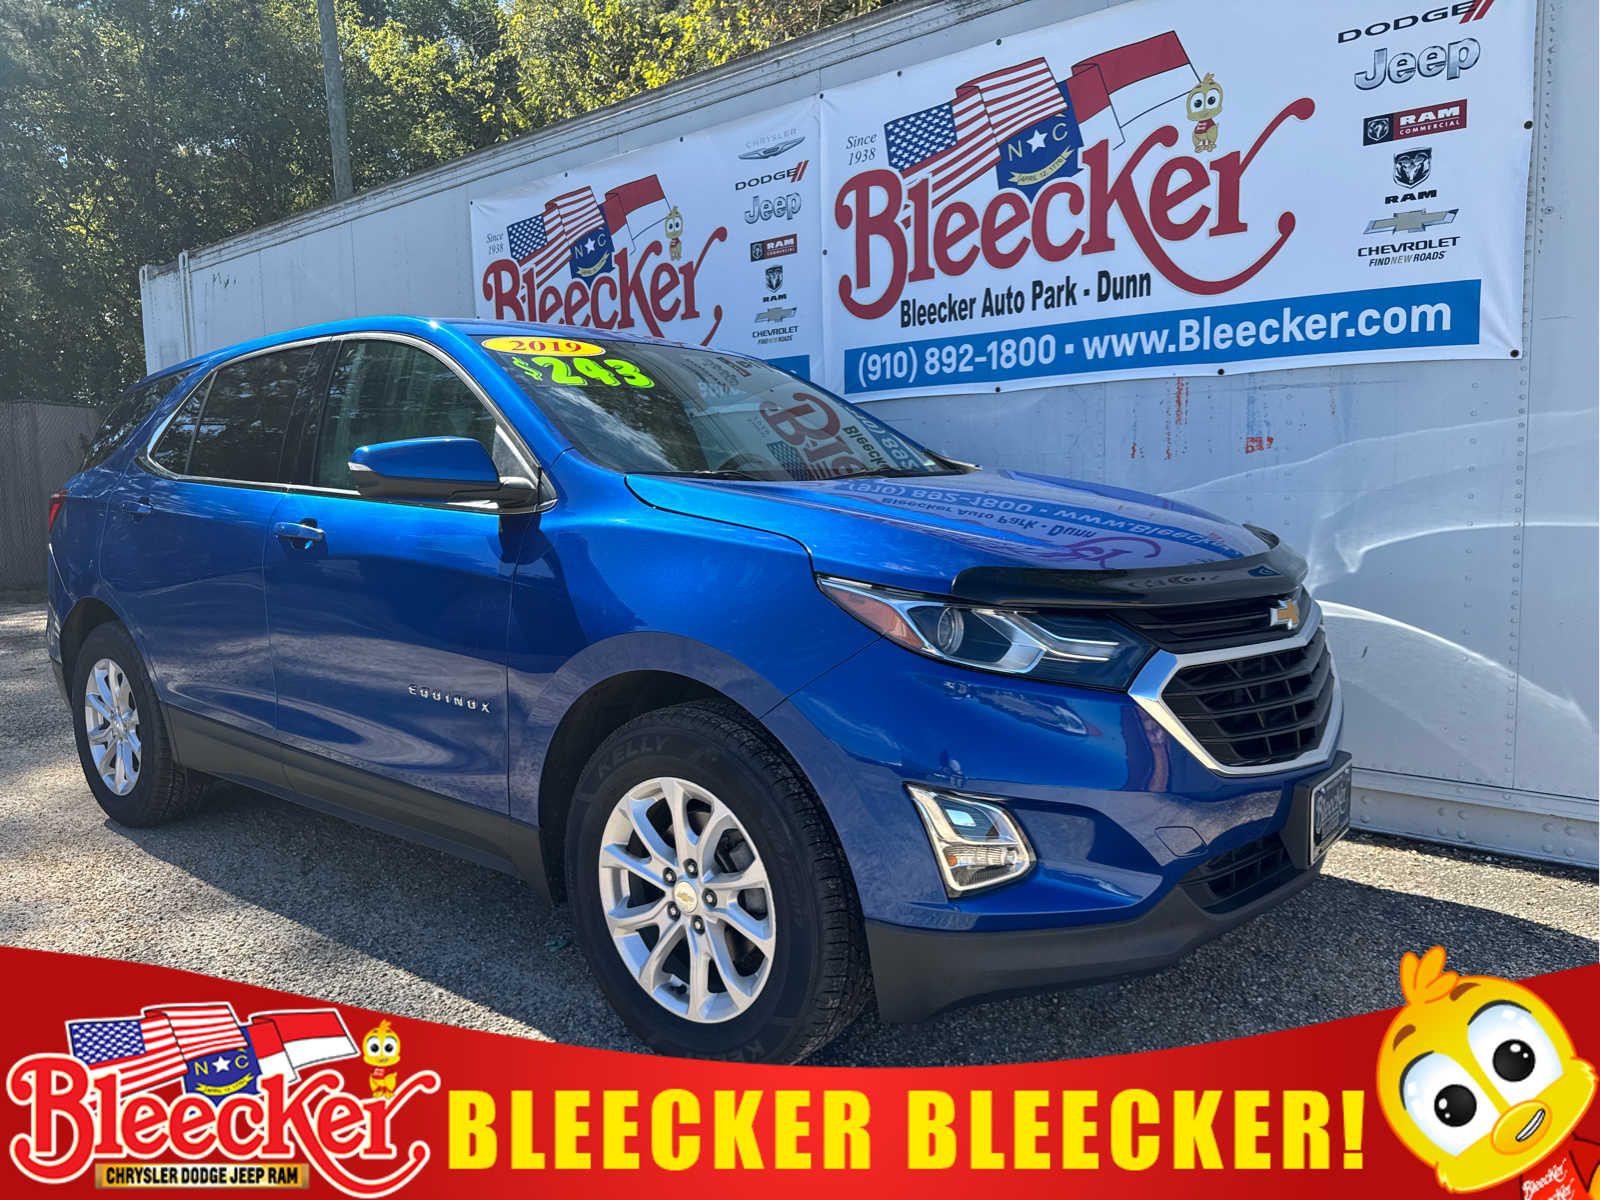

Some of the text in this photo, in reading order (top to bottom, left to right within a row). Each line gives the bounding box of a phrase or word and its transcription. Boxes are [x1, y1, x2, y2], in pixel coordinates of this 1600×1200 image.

[1338, 0, 1478, 43] DODGE
[1354, 37, 1481, 90] Jeep
[1400, 106, 1460, 125] RAM
[1400, 120, 1461, 135] COMMERCIAL
[846, 134, 877, 149] Since
[1008, 140, 1022, 161] N
[848, 147, 875, 166] 1938
[735, 168, 799, 190] DODGE
[1384, 189, 1437, 204] RAM
[744, 192, 802, 224] Jeep
[835, 97, 1315, 318] Bleecker
[767, 238, 794, 250] RAM
[1358, 236, 1461, 257] CHEVROLET
[762, 294, 788, 303] RAM
[901, 293, 976, 328] Bleecker
[981, 286, 1024, 318] Auto
[1032, 275, 1077, 311] Park
[1097, 270, 1151, 303] Dunn
[752, 326, 799, 338] CHEVROLET
[511, 340, 582, 352] 2019
[859, 303, 1451, 387] (910) 892-1800 www.Bleecker.com
[512, 356, 656, 388] $243
[408, 684, 491, 713] EQUINOX
[598, 736, 672, 780] KELLY
